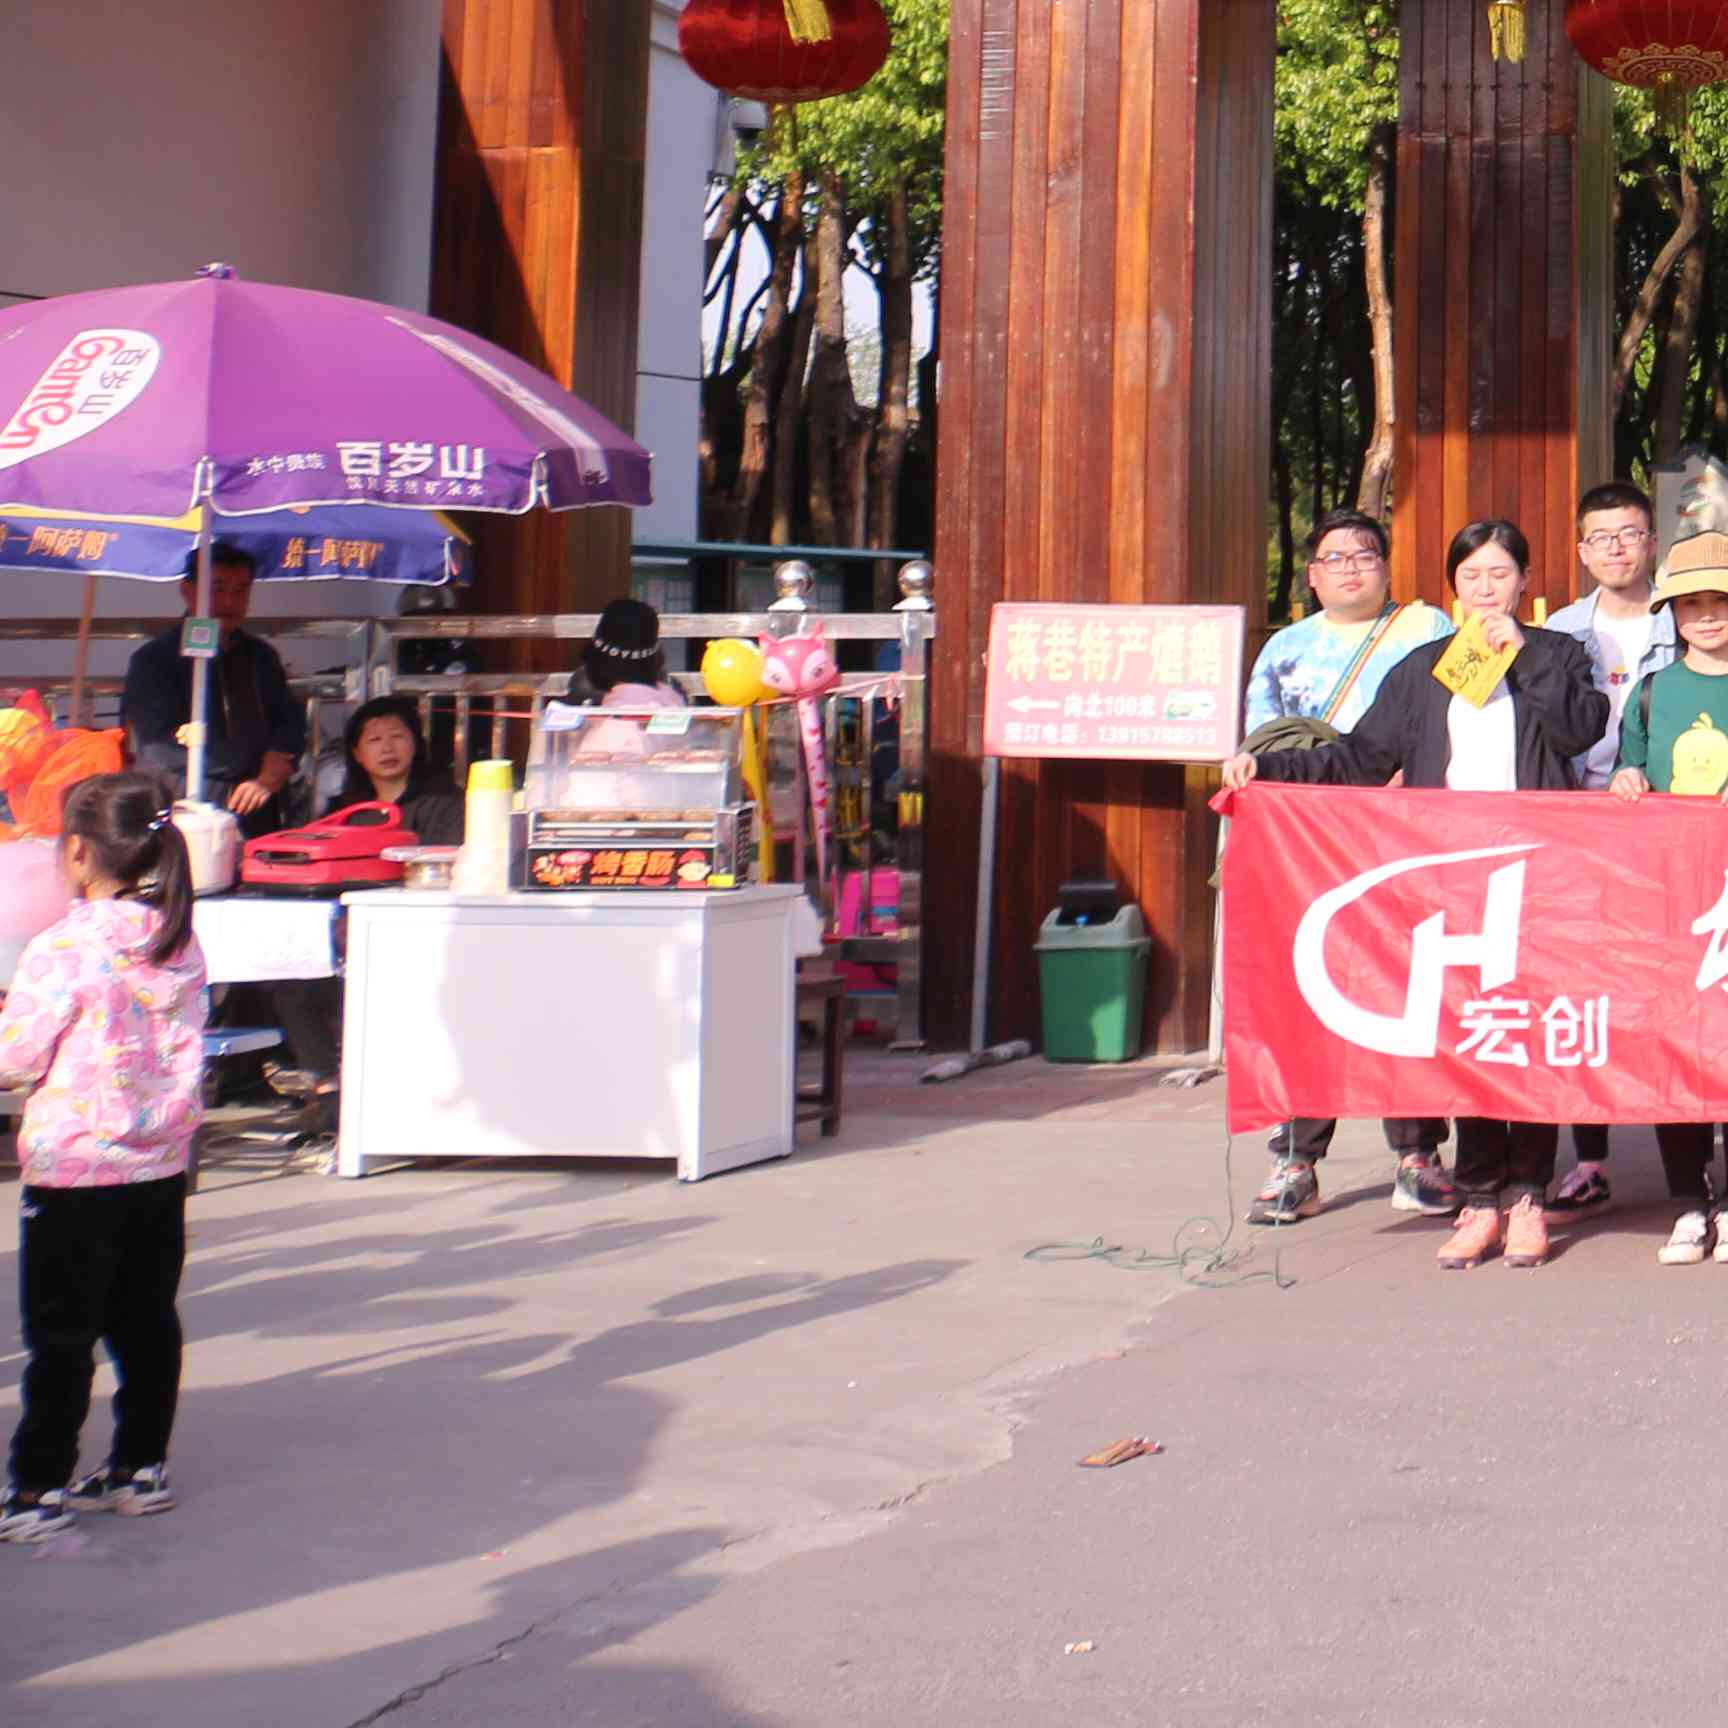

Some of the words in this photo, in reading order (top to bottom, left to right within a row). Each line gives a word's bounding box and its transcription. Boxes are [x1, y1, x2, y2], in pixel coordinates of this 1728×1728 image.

[336, 442, 485, 480] 百岁山
[0, 523, 108, 561] 一阿萨姆
[590, 850, 676, 876] 烤香肠
[1455, 995, 1609, 1068] 宏创
